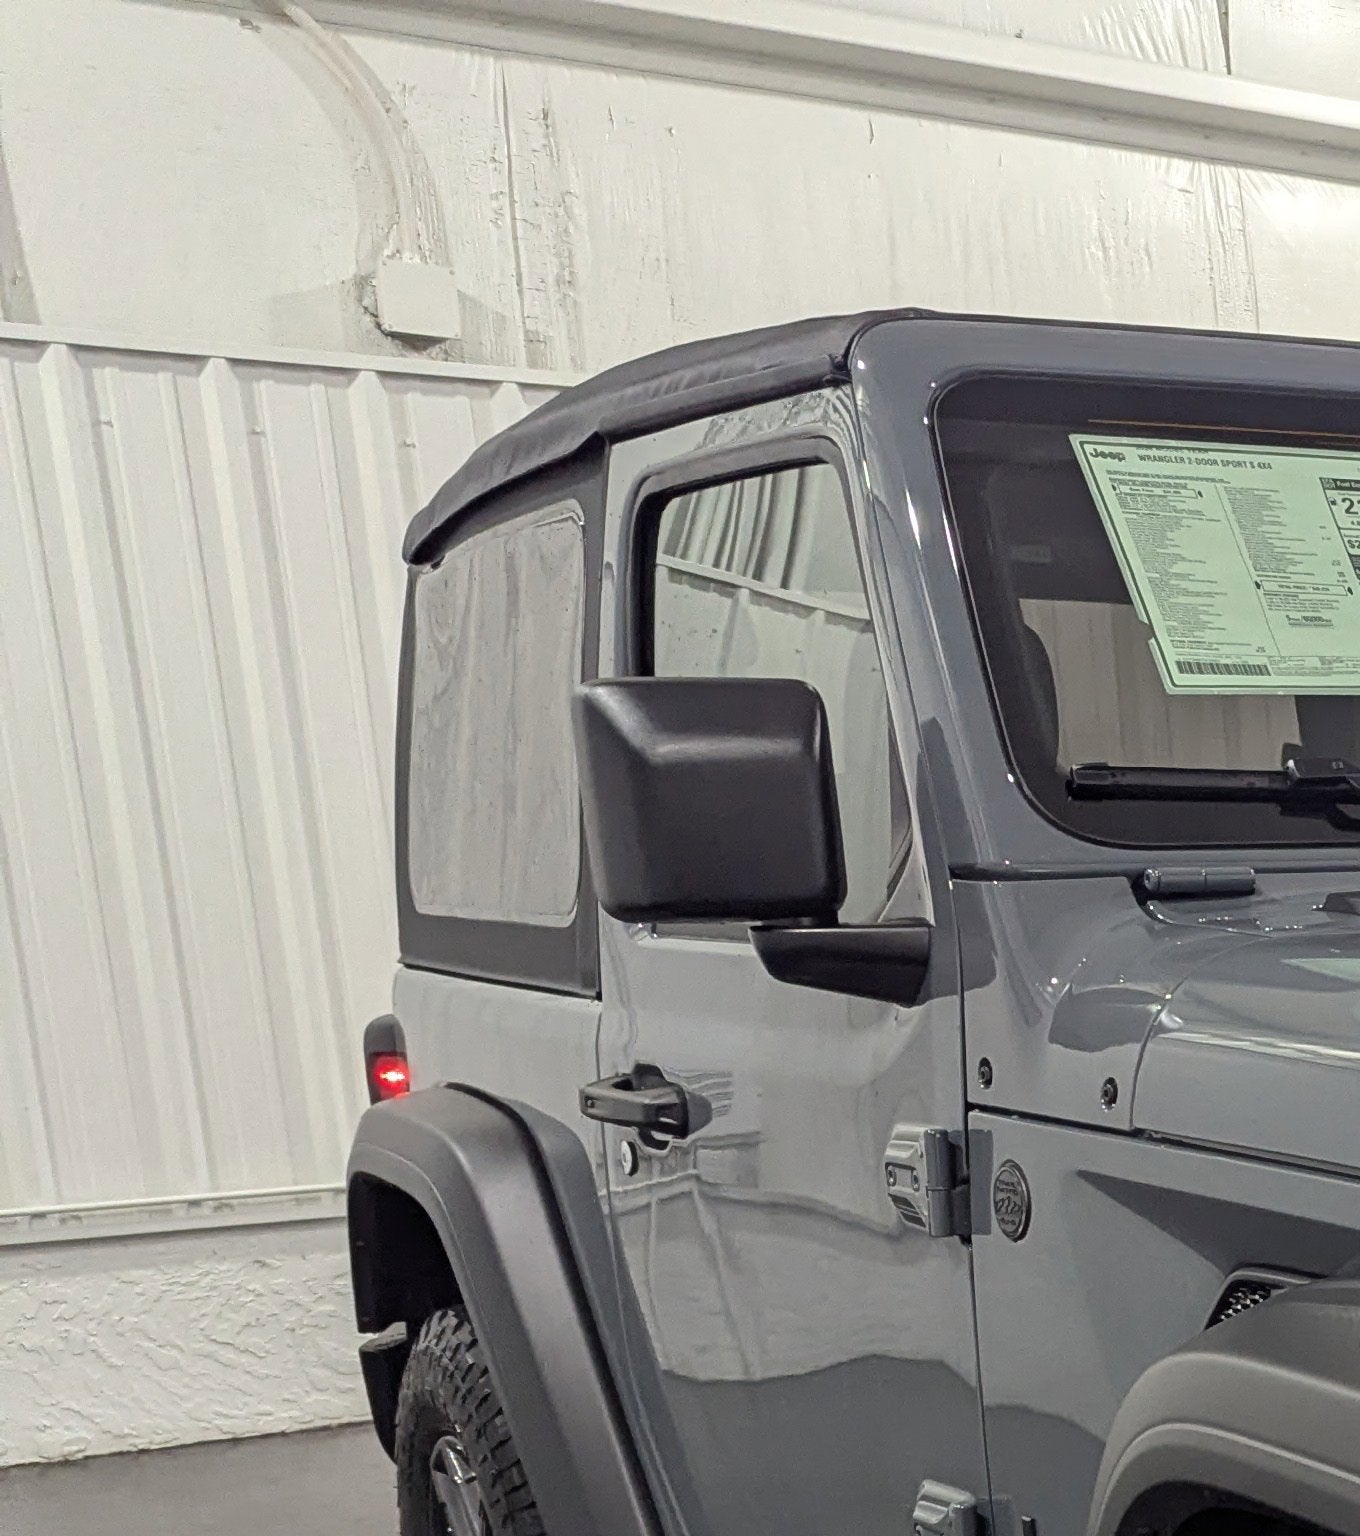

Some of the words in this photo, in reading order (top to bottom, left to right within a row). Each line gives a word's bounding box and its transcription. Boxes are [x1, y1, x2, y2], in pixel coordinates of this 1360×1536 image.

[1089, 448, 1126, 462] Jeep
[1137, 454, 1185, 465] WRANGLER
[1187, 456, 1219, 467] 2-DOOR
[1220, 459, 1248, 469] SPORT
